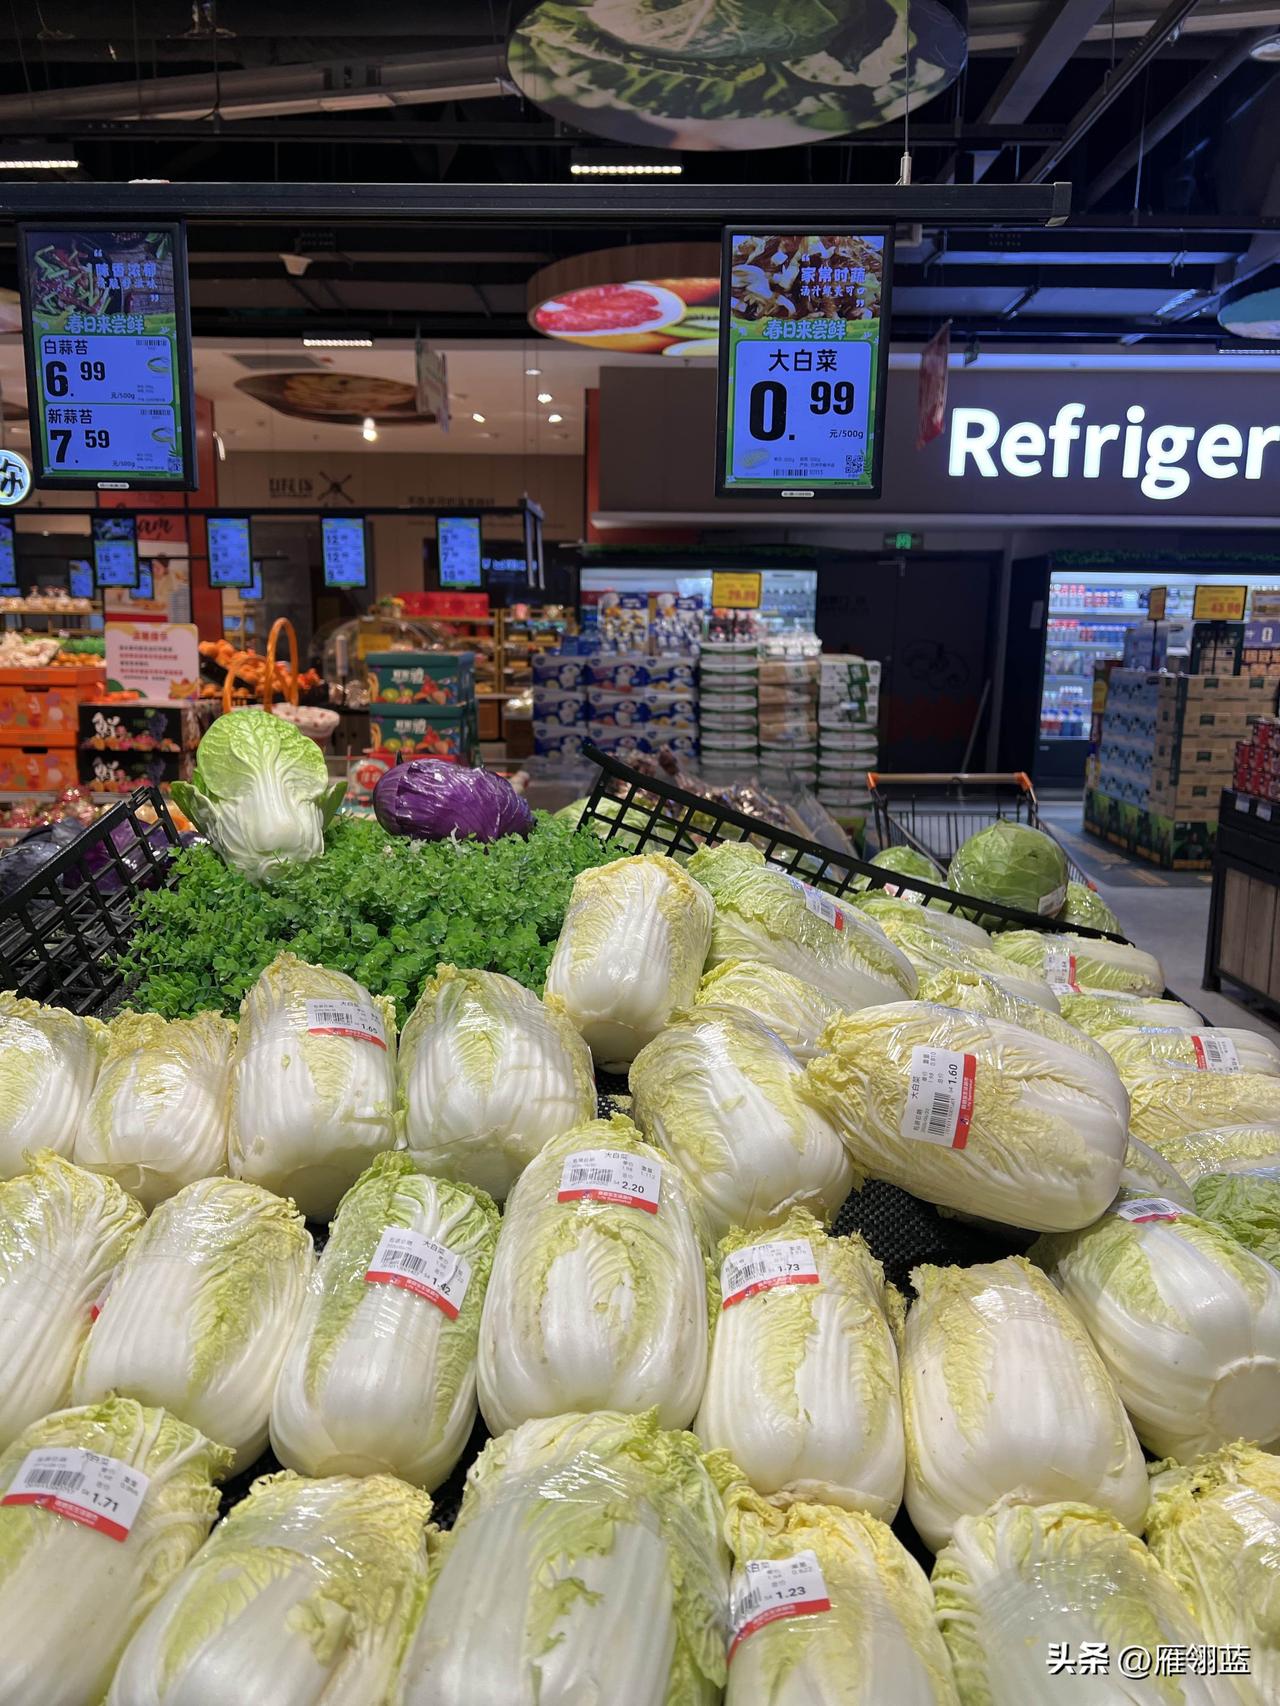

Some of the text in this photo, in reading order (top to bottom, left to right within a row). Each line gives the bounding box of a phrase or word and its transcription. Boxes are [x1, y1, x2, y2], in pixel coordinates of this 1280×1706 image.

[801, 266, 866, 283] 家常时蔬
[64, 314, 145, 334] 春日来尝鲜
[763, 319, 847, 339] 春日来尝鲜
[43, 339, 88, 354] 白蒜苔
[768, 348, 838, 373] 大白菜
[80, 361, 106, 381] 99
[809, 381, 855, 415] 99
[47, 408, 93, 424] 新蒜苔
[85, 430, 110, 448] 59
[829, 428, 864, 440] 元/500g
[948, 402, 1280, 500] Refriger
[948, 1064, 958, 1085] 1.60
[911, 1076, 921, 1099] 大白菜
[622, 1181, 645, 1193] 2.20
[779, 1263, 800, 1272] 1.73
[432, 1277, 451, 1296] 1.42
[92, 1492, 119, 1513] 1.71
[775, 1586, 806, 1599] 1.23
